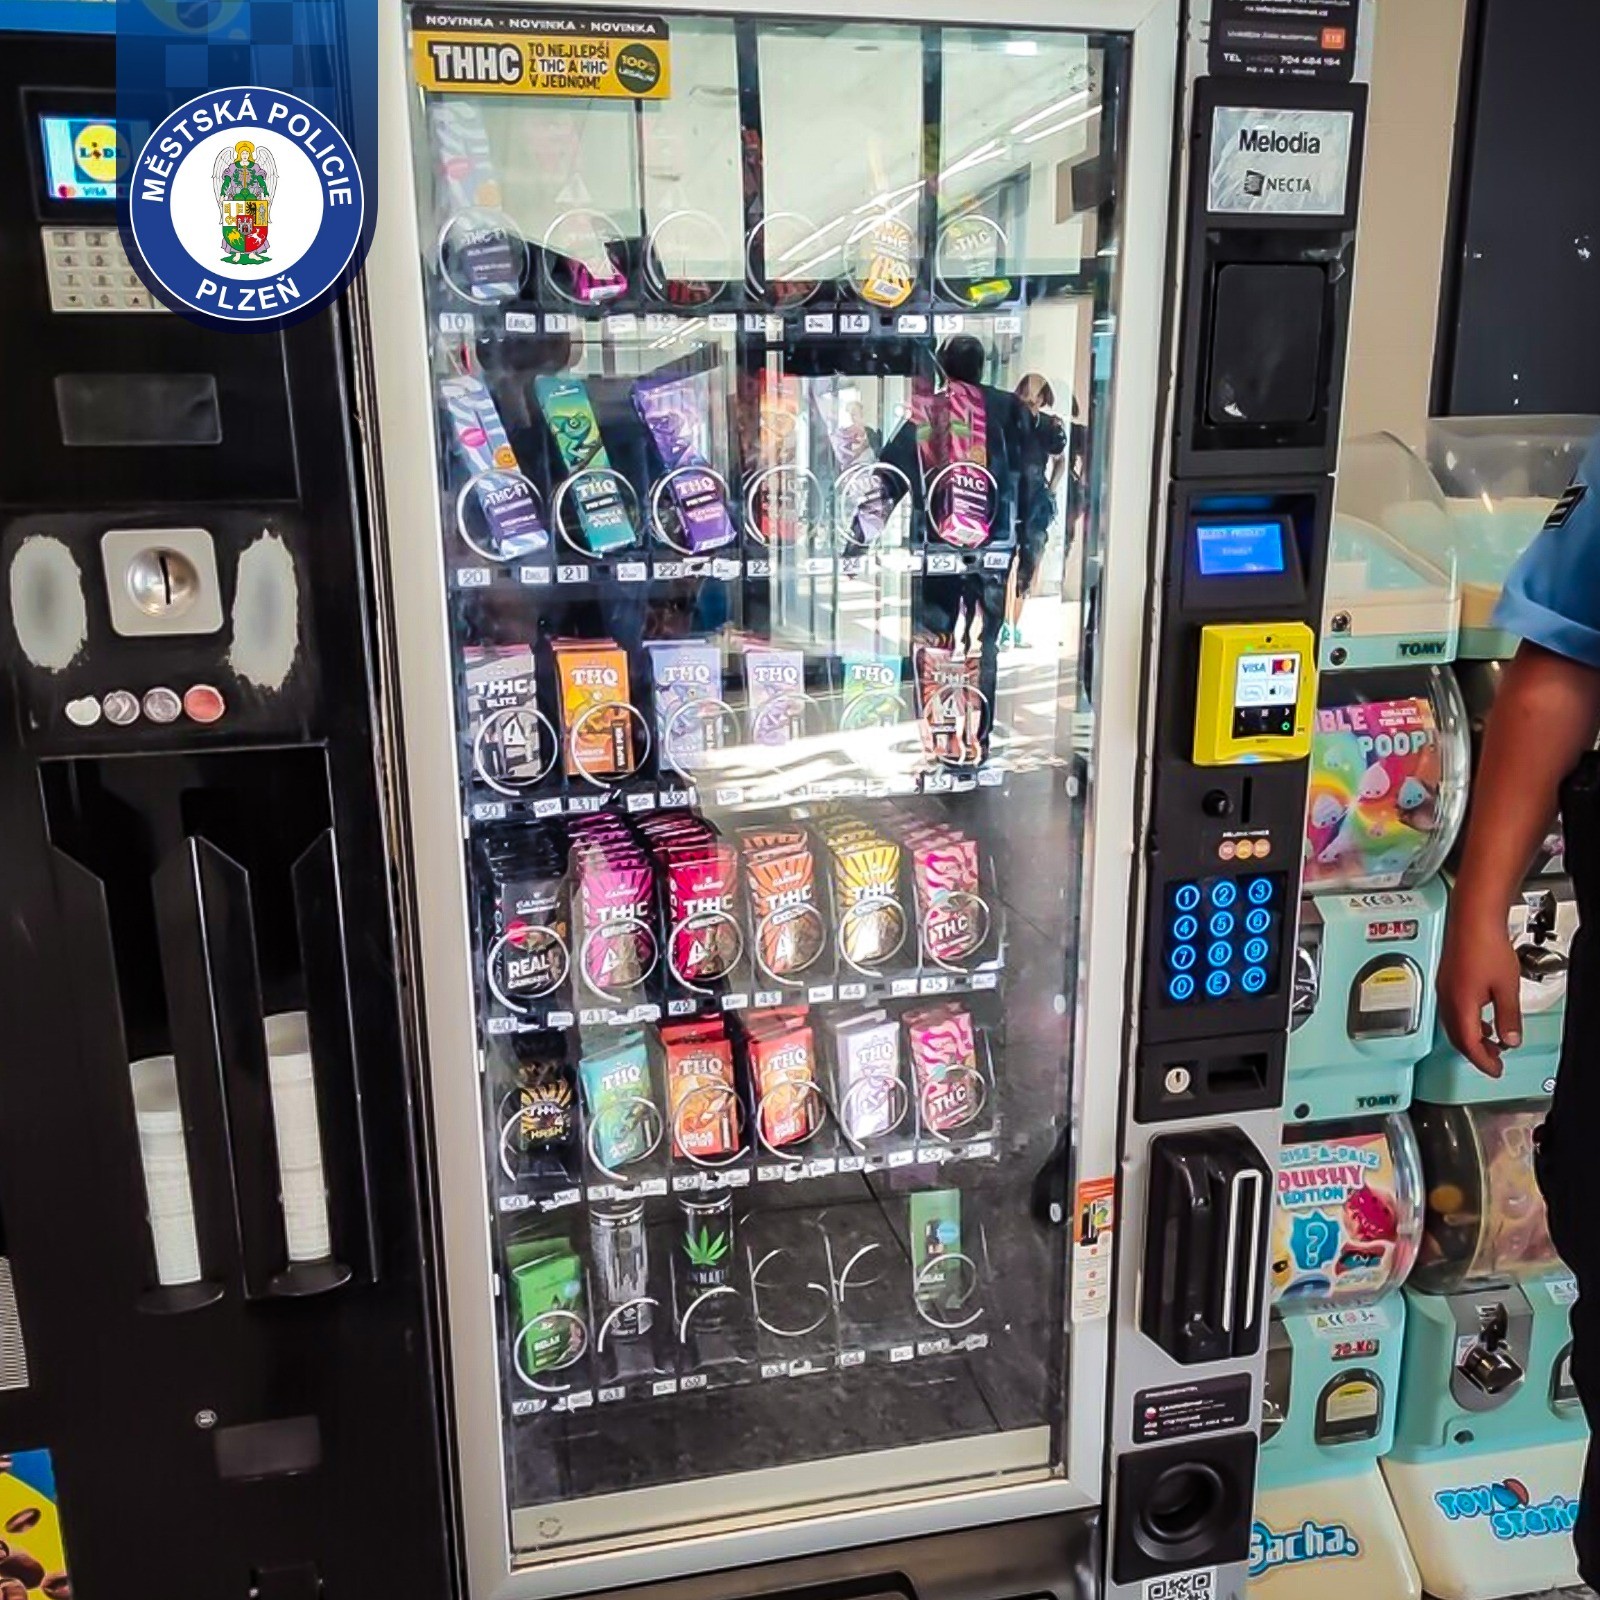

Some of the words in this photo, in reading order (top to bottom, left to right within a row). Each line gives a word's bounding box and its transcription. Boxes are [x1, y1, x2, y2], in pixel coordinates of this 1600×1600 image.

[425, 14, 494, 28] NOVINKA
[509, 17, 577, 31] NOVINKA
[590, 20, 656, 34] NOVINKA
[527, 42, 544, 57] TO
[547, 40, 610, 59] NEJLEPŠÍ
[431, 44, 521, 82] THHC
[540, 59, 565, 73] THC
[568, 60, 577, 74] A
[580, 60, 609, 75] HHC
[529, 74, 538, 88] V
[1239, 129, 1321, 154] Melodia
[1265, 178, 1312, 192] NECTA
[1399, 642, 1445, 656] TOMY
[570, 667, 619, 688] THQ
[663, 665, 711, 685] THQ
[754, 666, 799, 683] THQ
[850, 664, 895, 684] THQ
[1242, 662, 1267, 674] VISA
[933, 915, 969, 938] THC
[508, 956, 551, 979] REAL
[1356, 1094, 1400, 1109] TOMY
[1283, 1186, 1345, 1205] EDITION
[1436, 1485, 1492, 1519] TOY
